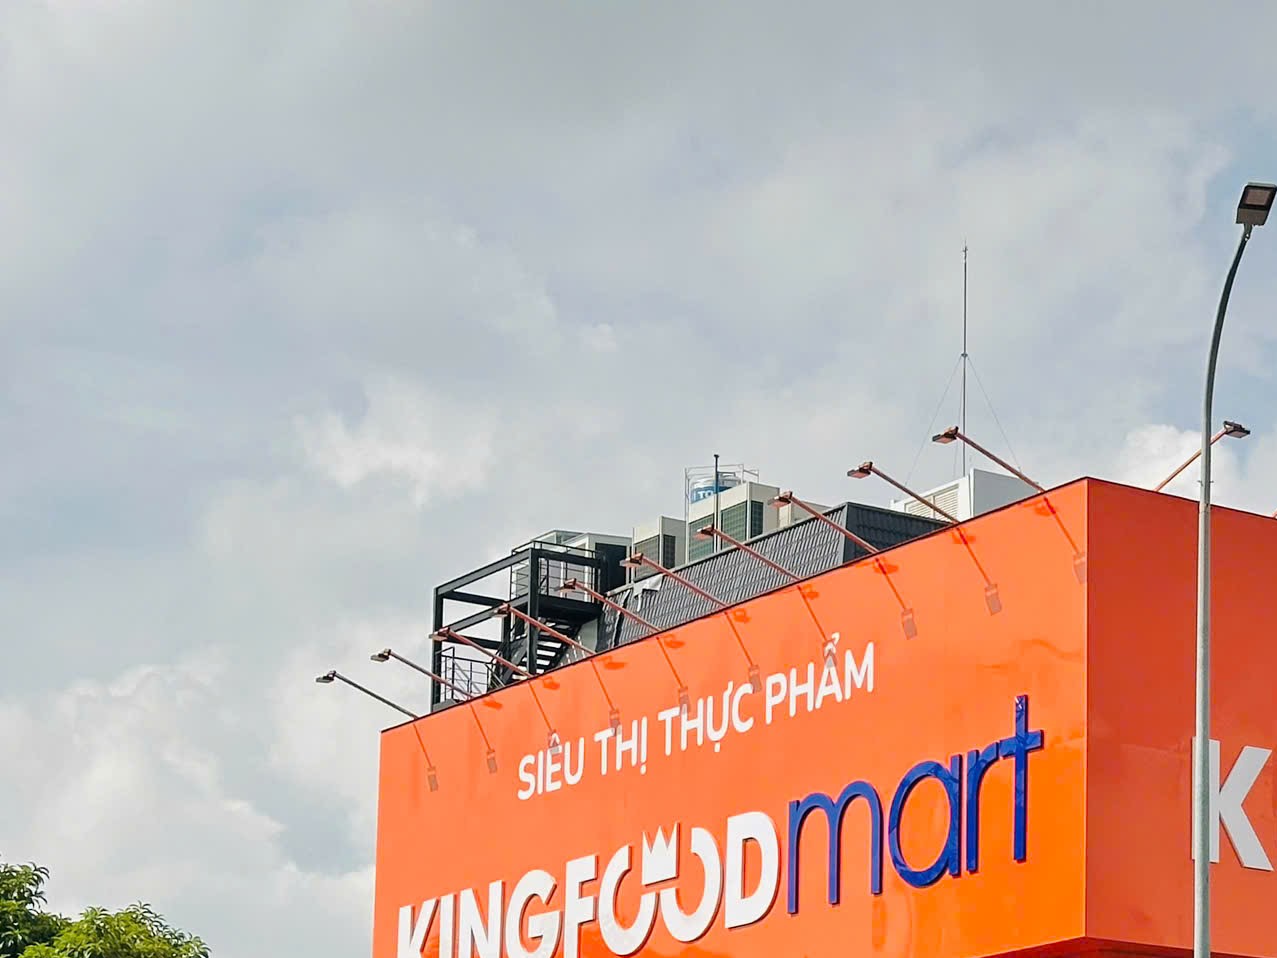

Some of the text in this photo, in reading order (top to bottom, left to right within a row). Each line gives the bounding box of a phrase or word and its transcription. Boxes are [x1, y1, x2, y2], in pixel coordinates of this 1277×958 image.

[517, 632, 875, 802] SIÊU THỊ THỰC PHẨM
